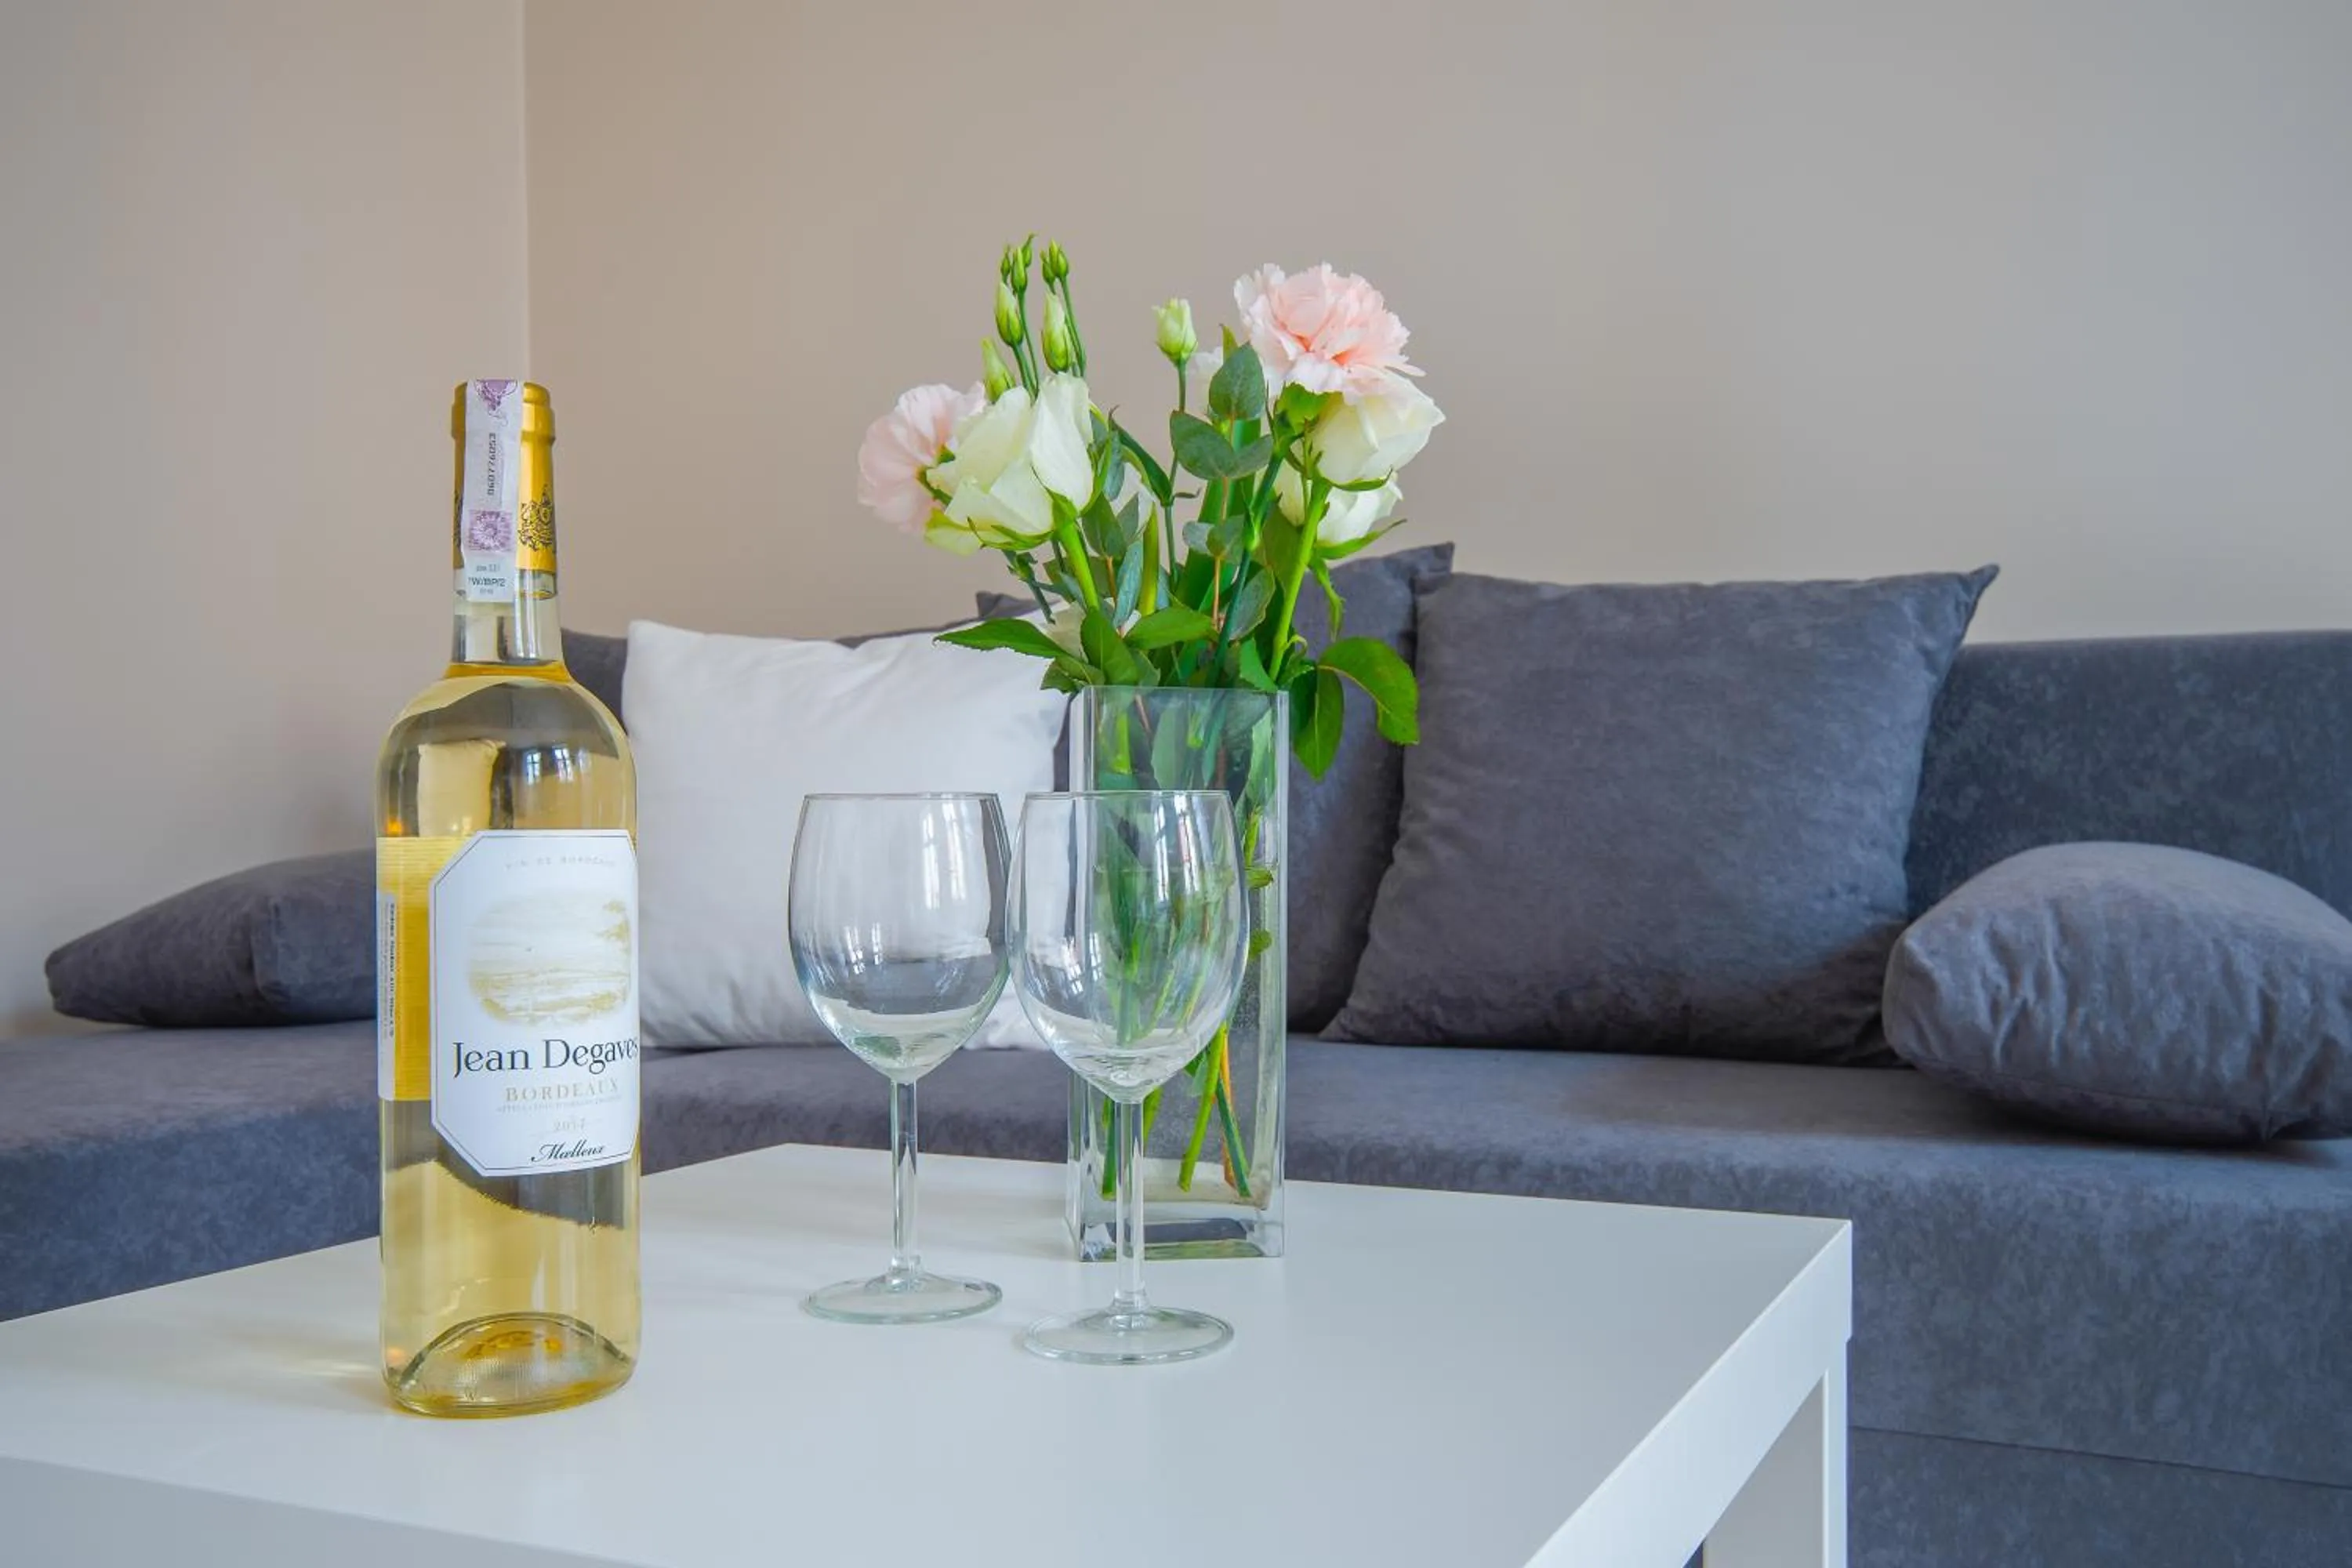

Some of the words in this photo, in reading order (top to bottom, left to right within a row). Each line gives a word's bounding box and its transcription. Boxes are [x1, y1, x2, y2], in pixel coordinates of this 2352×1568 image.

[452, 1042, 532, 1079] Jean
[543, 1037, 638, 1075] Degaves
[505, 1077, 619, 1102] BORDEAUX
